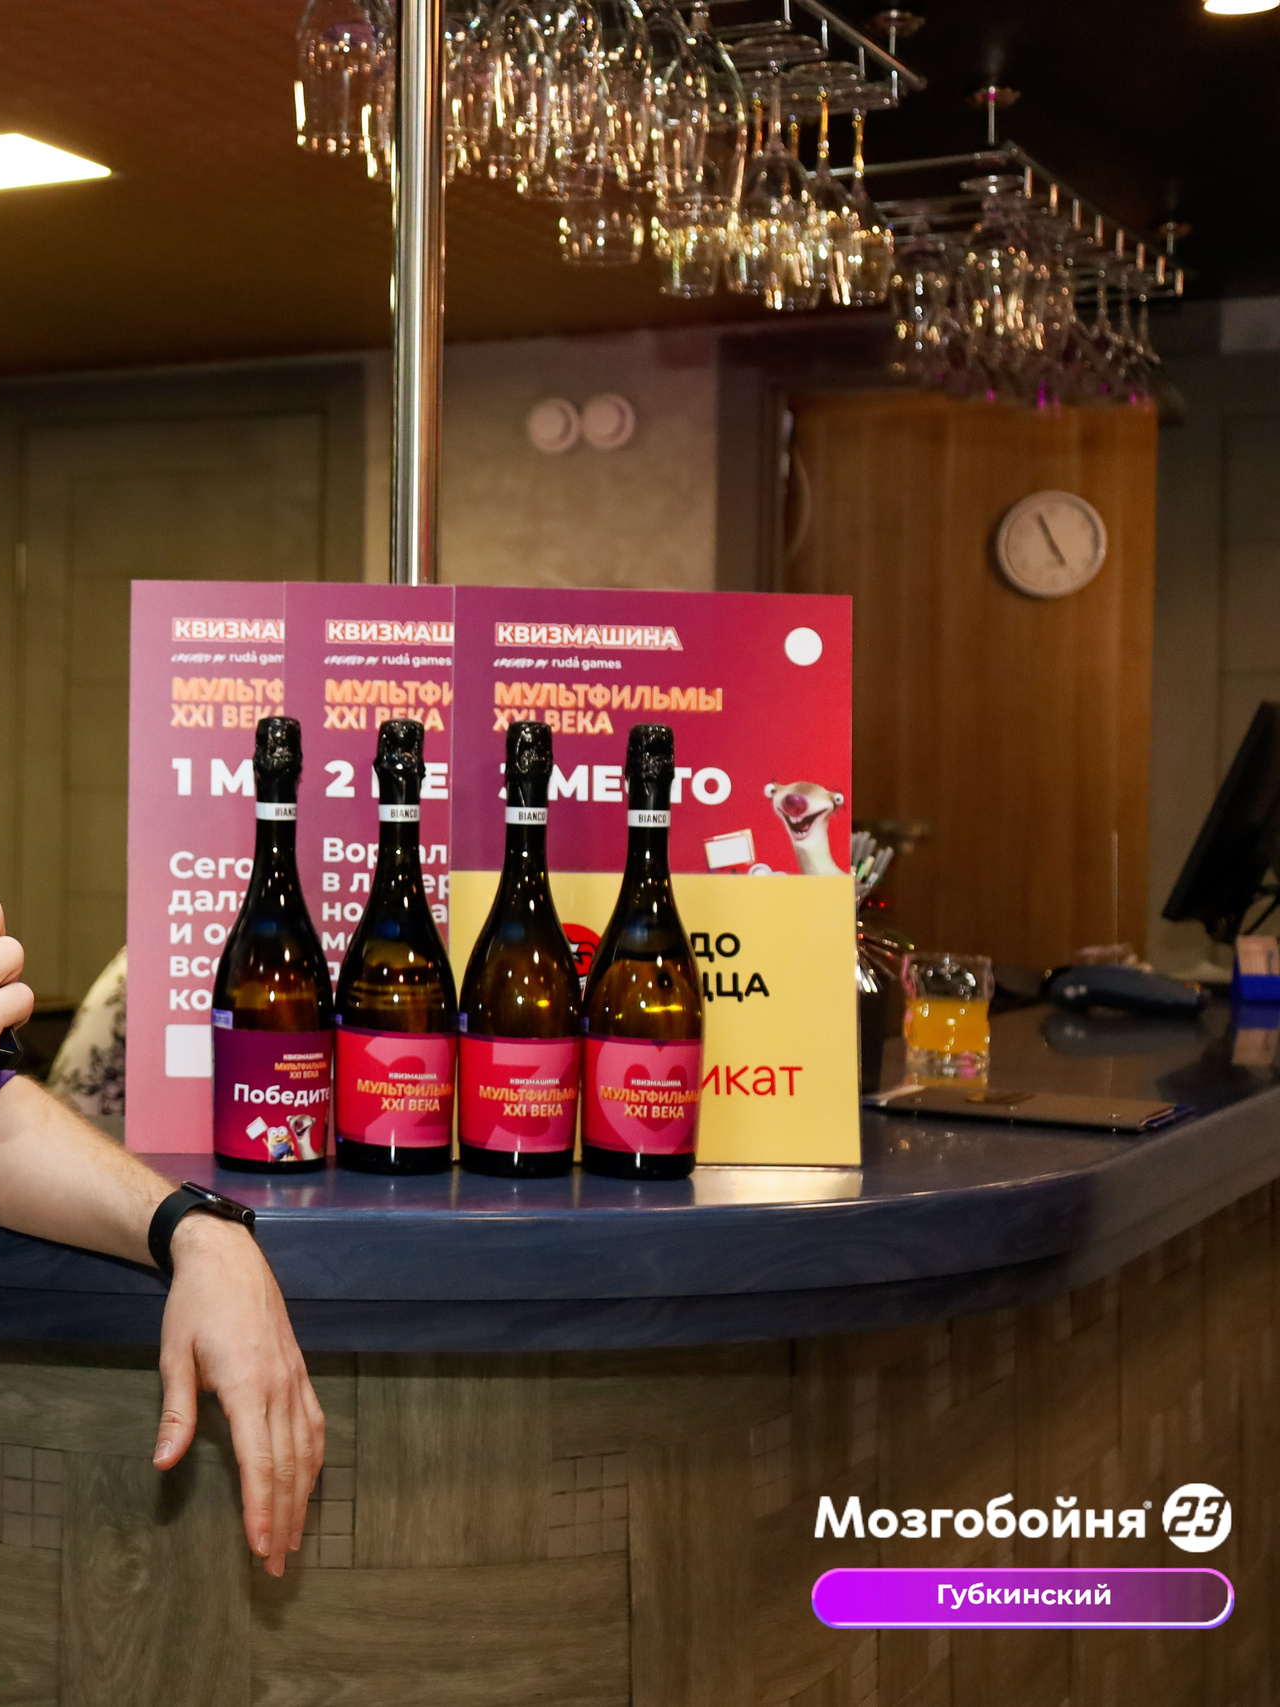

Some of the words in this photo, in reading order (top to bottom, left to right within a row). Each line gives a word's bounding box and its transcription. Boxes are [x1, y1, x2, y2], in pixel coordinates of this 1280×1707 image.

[497, 624, 680, 648] КВИЗМАШИНА
[411, 657, 452, 668] games
[581, 659, 622, 671] games
[494, 681, 723, 712] МУЛЬТФИЛЬМЫ
[170, 703, 214, 727] XXI
[323, 705, 367, 730] XXI
[544, 710, 614, 735] ВЕКА
[172, 758, 192, 795] 1
[324, 760, 355, 797] 2
[548, 764, 732, 805] МЕТО
[390, 808, 418, 819] BIANCO
[518, 811, 546, 821] BIANCO
[638, 813, 667, 824] BIANCO
[322, 872, 341, 892] в
[381, 1097, 405, 1111] XXI
[408, 1098, 440, 1111] ВЕКА
[503, 1103, 527, 1117] XXI
[530, 1104, 563, 1117] ВЕКА
[624, 1104, 648, 1118] XXI
[651, 1105, 685, 1119] ВЕКА
